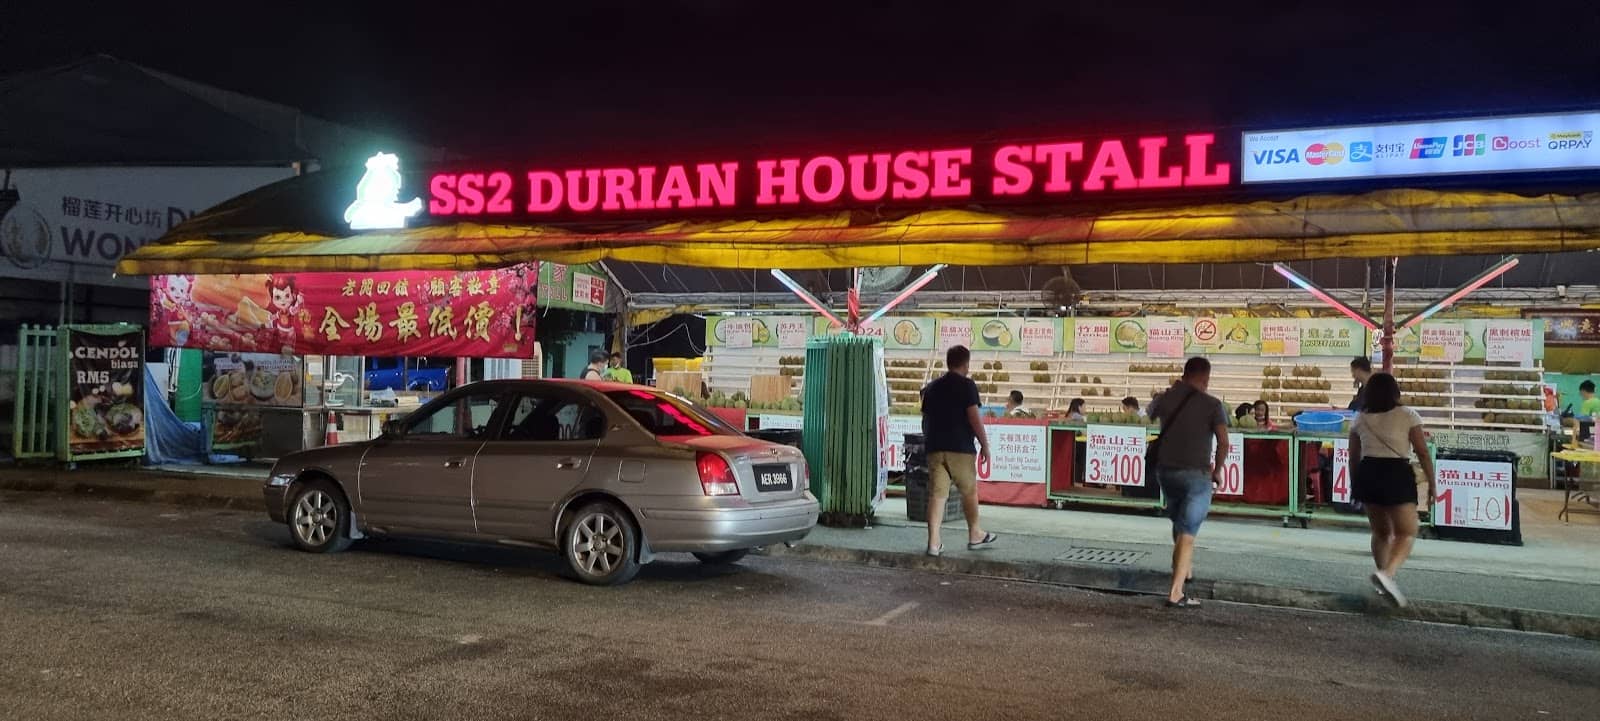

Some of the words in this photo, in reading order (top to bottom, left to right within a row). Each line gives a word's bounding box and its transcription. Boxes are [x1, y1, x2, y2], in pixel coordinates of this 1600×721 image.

[1253, 148, 1300, 165] VISA
[430, 173, 511, 214] SS2
[528, 163, 738, 212] DURIAN
[757, 149, 972, 204] HOUSE
[993, 134, 1230, 195] STALL
[75, 346, 139, 359] CENDOL
[76, 370, 109, 384] RM5
[1089, 443, 1122, 453] Musang
[1090, 435, 1142, 446] 猫山王
[1089, 458, 1101, 481] 3
[1110, 454, 1142, 485] 100
[1440, 470, 1510, 482] 猫山王
[1333, 465, 1348, 501] 4
[1438, 480, 1481, 488] Musang
[1484, 482, 1510, 490] King
[1436, 489, 1452, 525] 1
